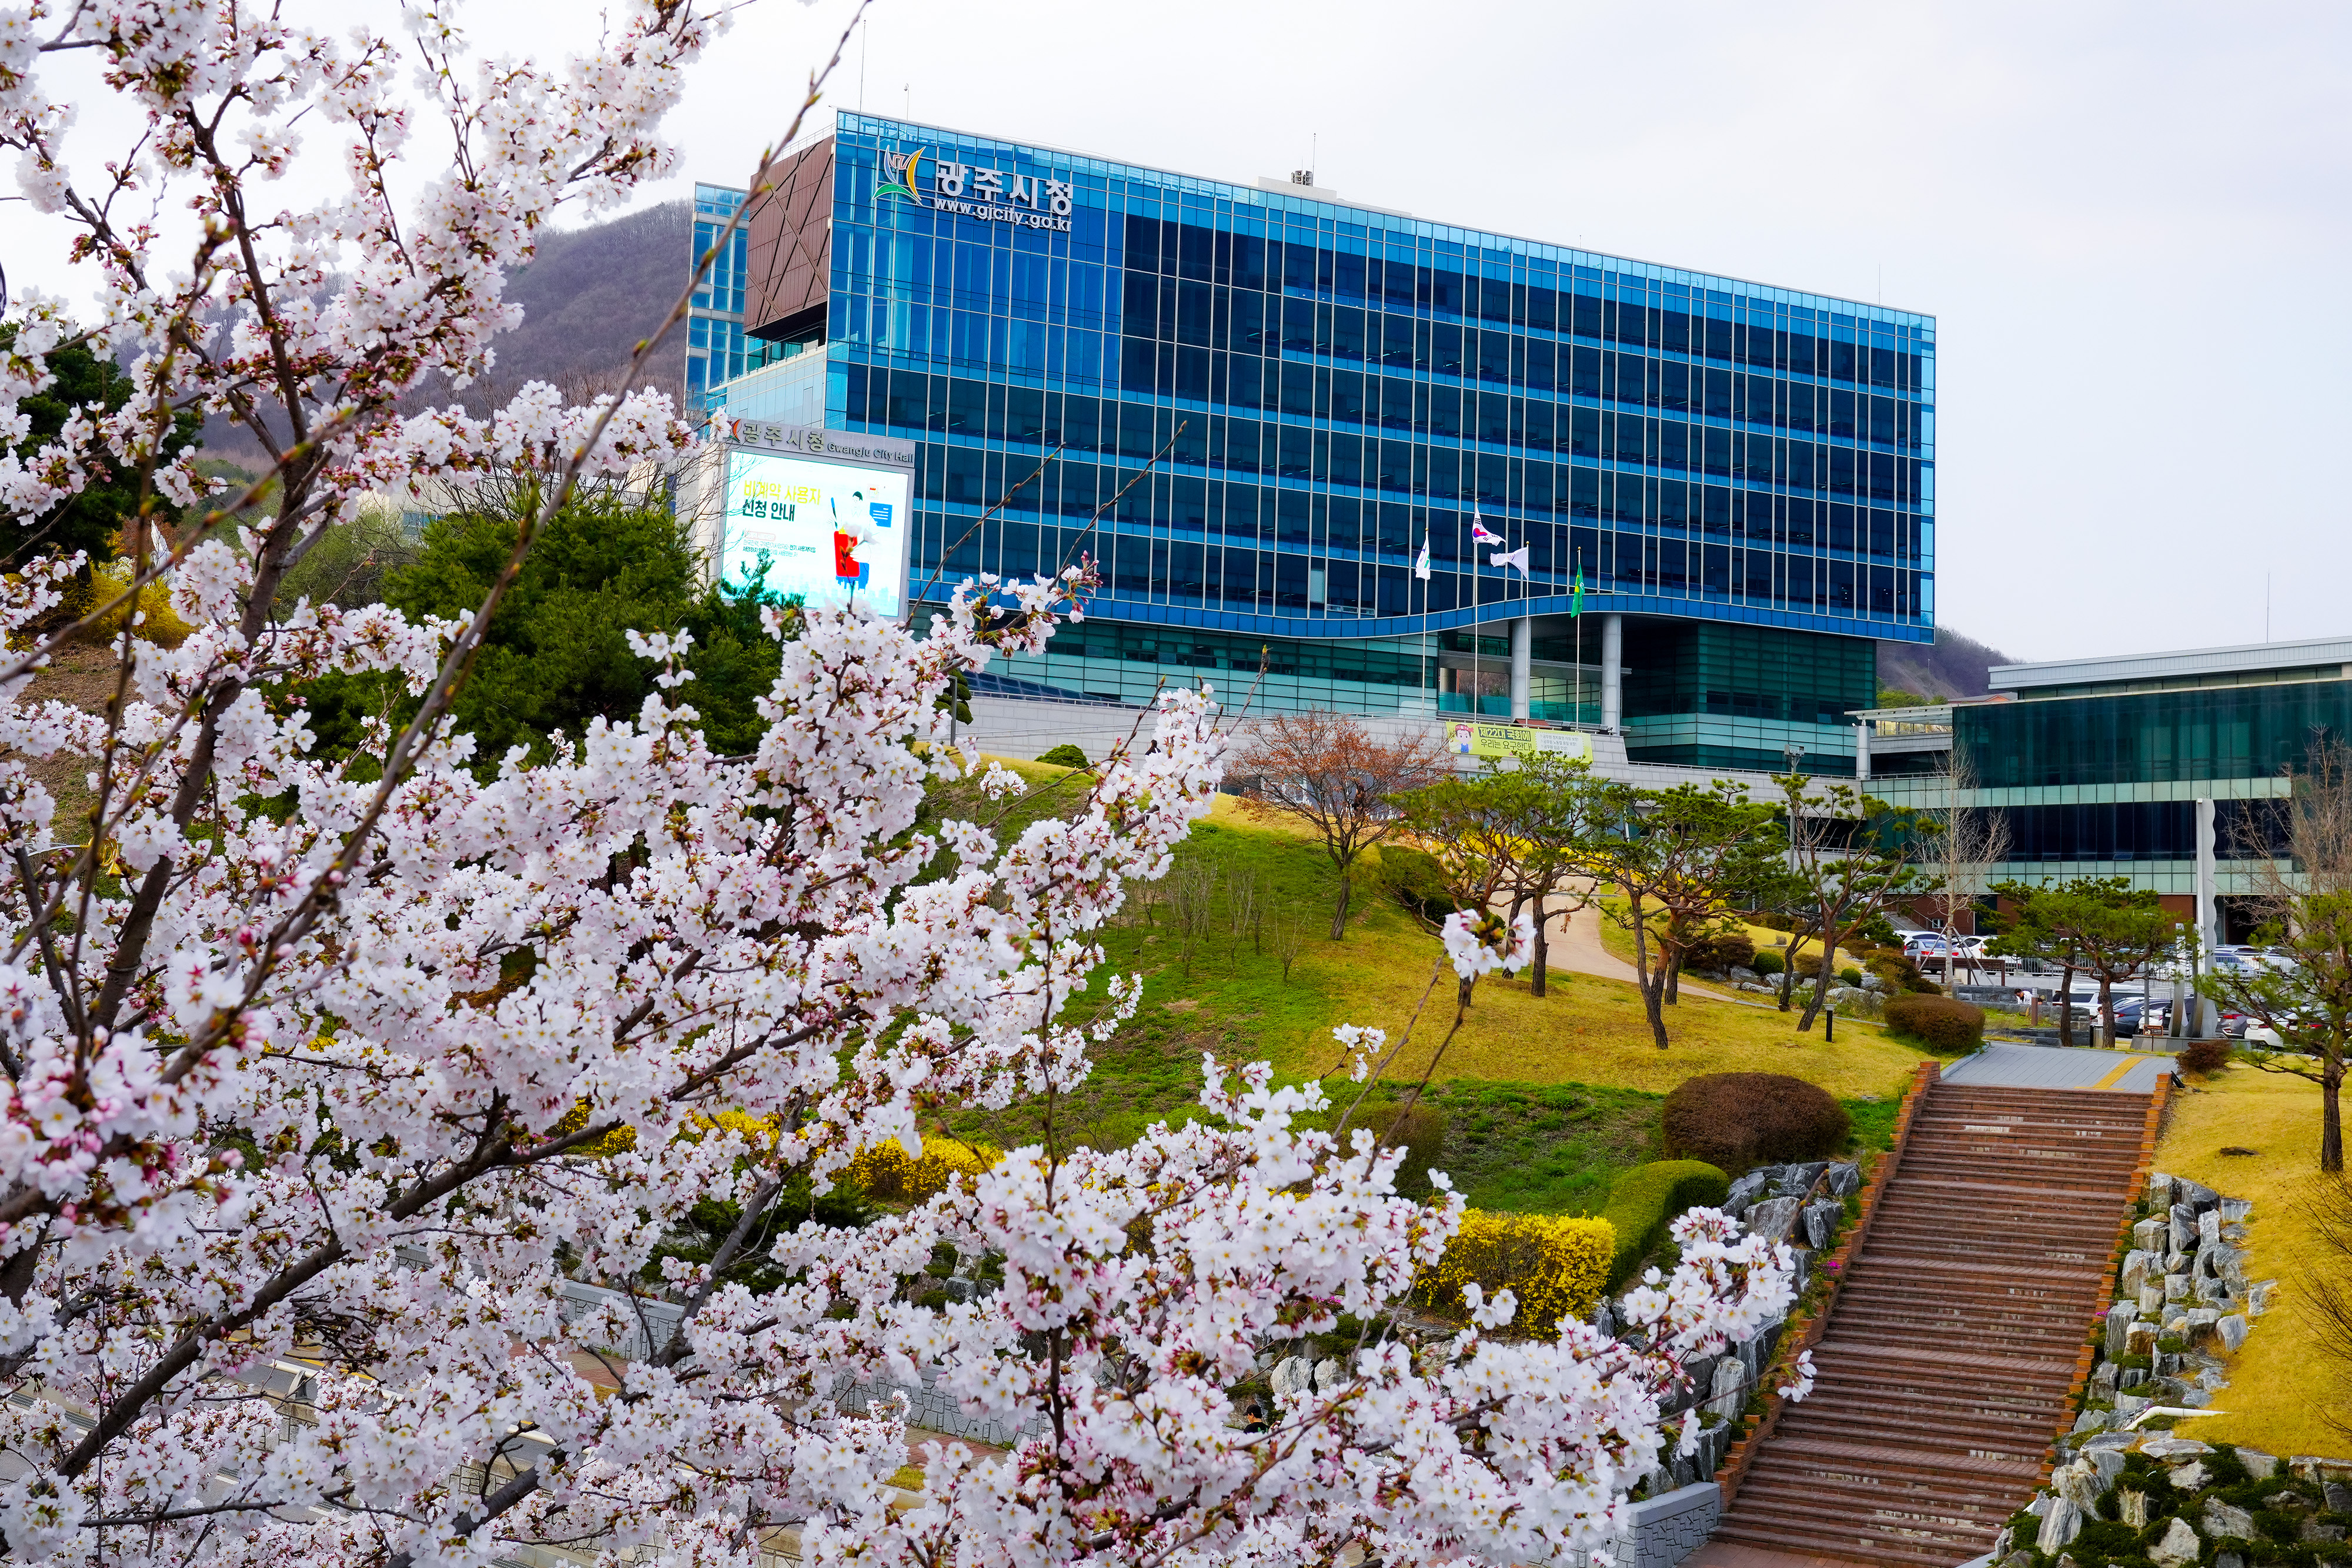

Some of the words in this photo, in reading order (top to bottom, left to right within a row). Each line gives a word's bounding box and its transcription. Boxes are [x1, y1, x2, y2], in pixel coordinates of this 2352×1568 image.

[936, 160, 1073, 216] 광주시청
[934, 198, 1072, 232] www.gjcity.go.kr
[743, 423, 825, 452] 광주시청
[827, 442, 871, 457] Gwangju
[873, 448, 894, 462] City
[895, 451, 914, 463] Hall
[744, 480, 781, 500] 비계약
[784, 486, 821, 505] 사용자
[743, 499, 767, 518] 신청
[771, 502, 795, 521] 안내
[1479, 727, 1505, 739] 제22대
[1506, 729, 1531, 741] 국회에
[1481, 738, 1501, 748] 우리는
[1503, 741, 1532, 751] 요구한다!
